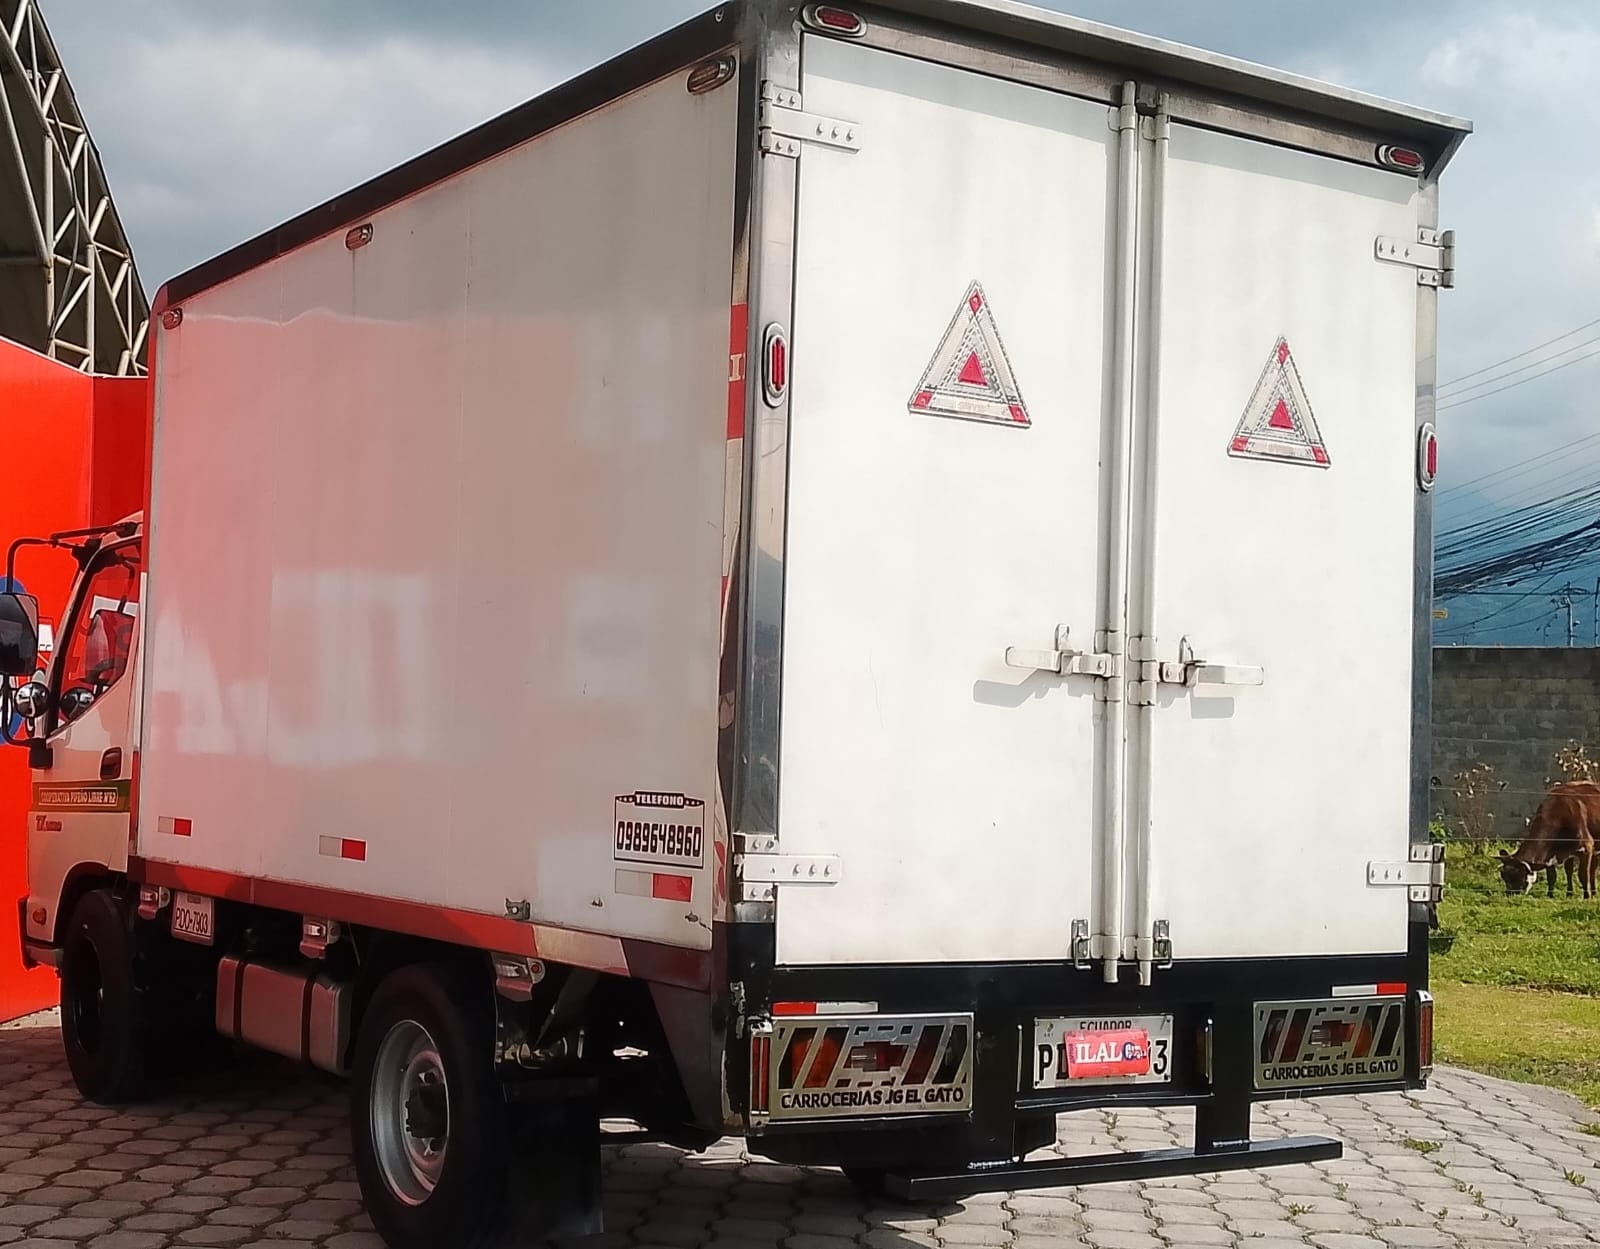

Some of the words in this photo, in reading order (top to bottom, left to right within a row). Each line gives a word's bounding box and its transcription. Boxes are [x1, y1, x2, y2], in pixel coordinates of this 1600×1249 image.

[635, 794, 684, 807] TELEFONO
[616, 820, 702, 858] 0989648960
[1074, 1041, 1123, 1064] ILAL
[1262, 1063, 1338, 1081] CARROCERIAS
[1340, 1062, 1354, 1076] JG
[1355, 1061, 1368, 1075] EL
[1369, 1059, 1399, 1073] GATO
[781, 1090, 883, 1109] CARROCERIAS
[884, 1089, 903, 1105] JG
[905, 1088, 922, 1104] EL
[924, 1087, 964, 1103] GATO
